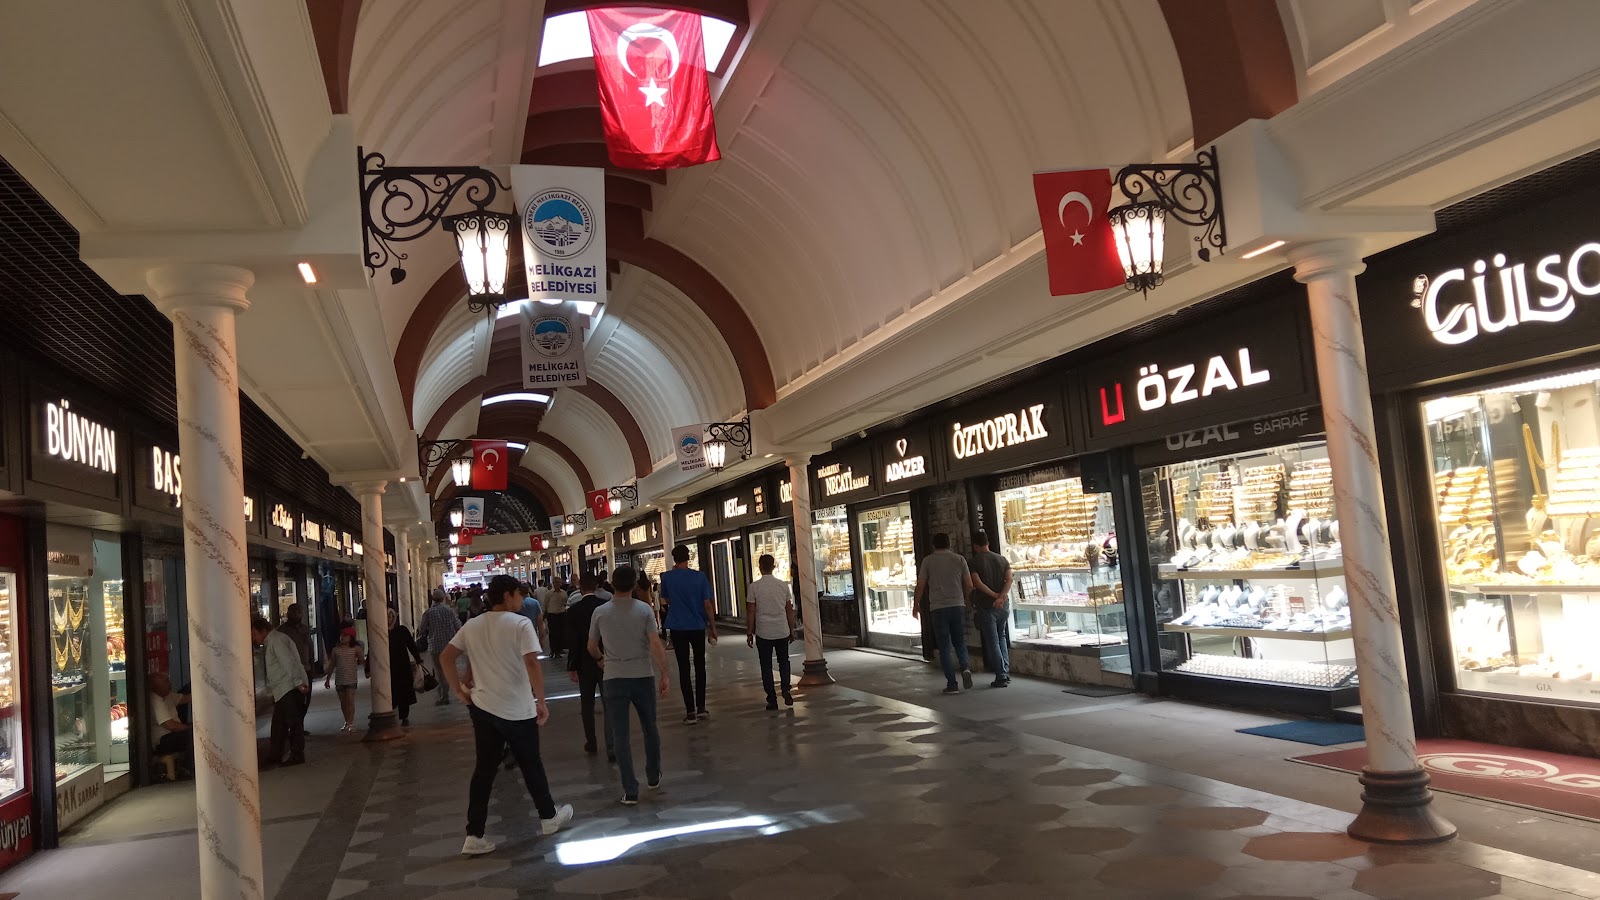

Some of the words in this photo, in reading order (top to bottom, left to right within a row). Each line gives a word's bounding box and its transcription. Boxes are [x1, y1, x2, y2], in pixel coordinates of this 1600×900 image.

[529, 263, 596, 277] MELİKGAZİ
[532, 280, 596, 293] BELEDİYESİ
[529, 361, 578, 371] MELİKGAZİ
[530, 372, 579, 383] BELEDİYESİ
[1137, 347, 1270, 411] ÖZAL
[953, 403, 1048, 459] ÖZTOPRAK
[1253, 412, 1309, 435] SARRAF
[47, 398, 116, 474] BÜNYAN
[886, 456, 926, 482] ADAZER
[825, 466, 853, 496] NECATİ
[1536, 683, 1552, 692] GIA
